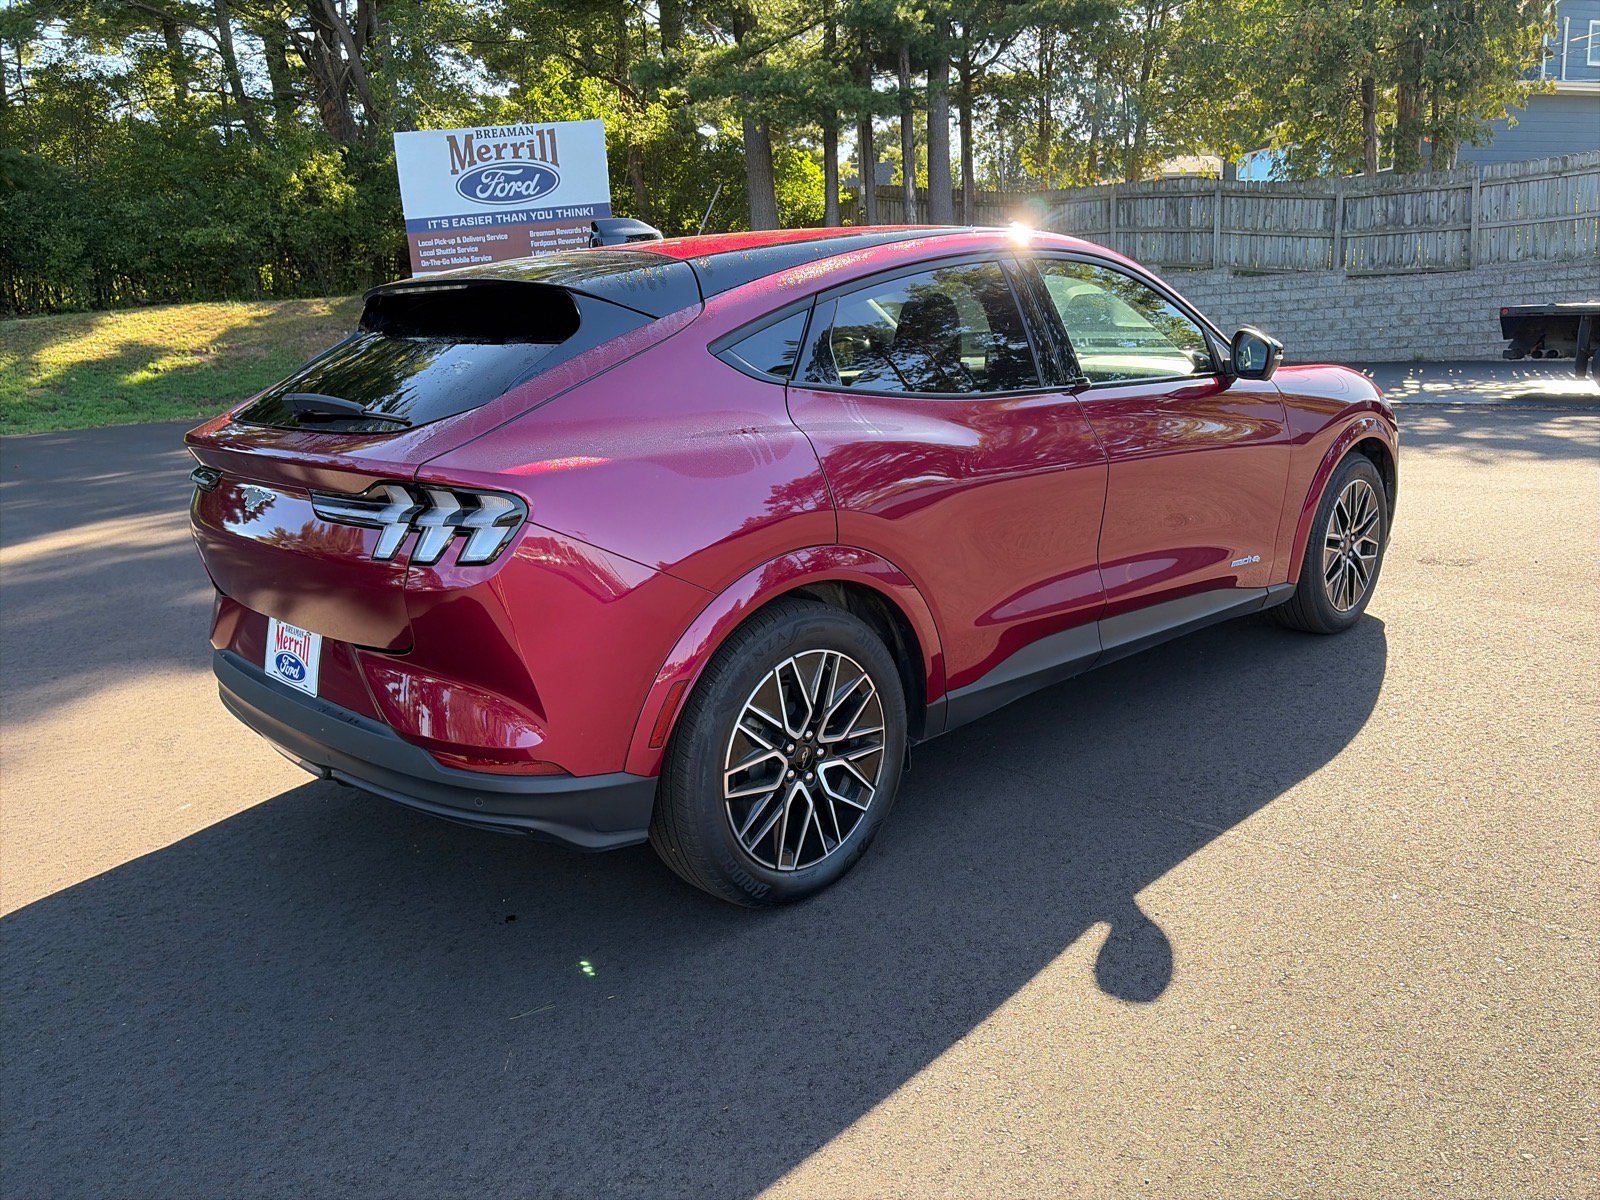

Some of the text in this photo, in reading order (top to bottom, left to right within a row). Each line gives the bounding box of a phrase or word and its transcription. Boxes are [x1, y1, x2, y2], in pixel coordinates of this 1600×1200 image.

[475, 126, 534, 140] BREAMAN
[446, 128, 560, 176] Merrill
[476, 168, 541, 199] Ford
[428, 207, 594, 229] IT'S EASIER THAN YOU THINK!
[529, 229, 556, 238] Breaman
[556, 227, 581, 235] Rewards
[417, 233, 508, 247] Local Pick-up & Delivery Service
[530, 239, 557, 248] Fordpass
[557, 237, 583, 245] Rewards
[419, 245, 479, 257] Local Shuttle Service
[420, 254, 493, 267] On-The-Go Mobile Service
[285, 624, 305, 638] BREAMAN
[274, 624, 311, 667] Merrill
[280, 654, 300, 679] Ford
